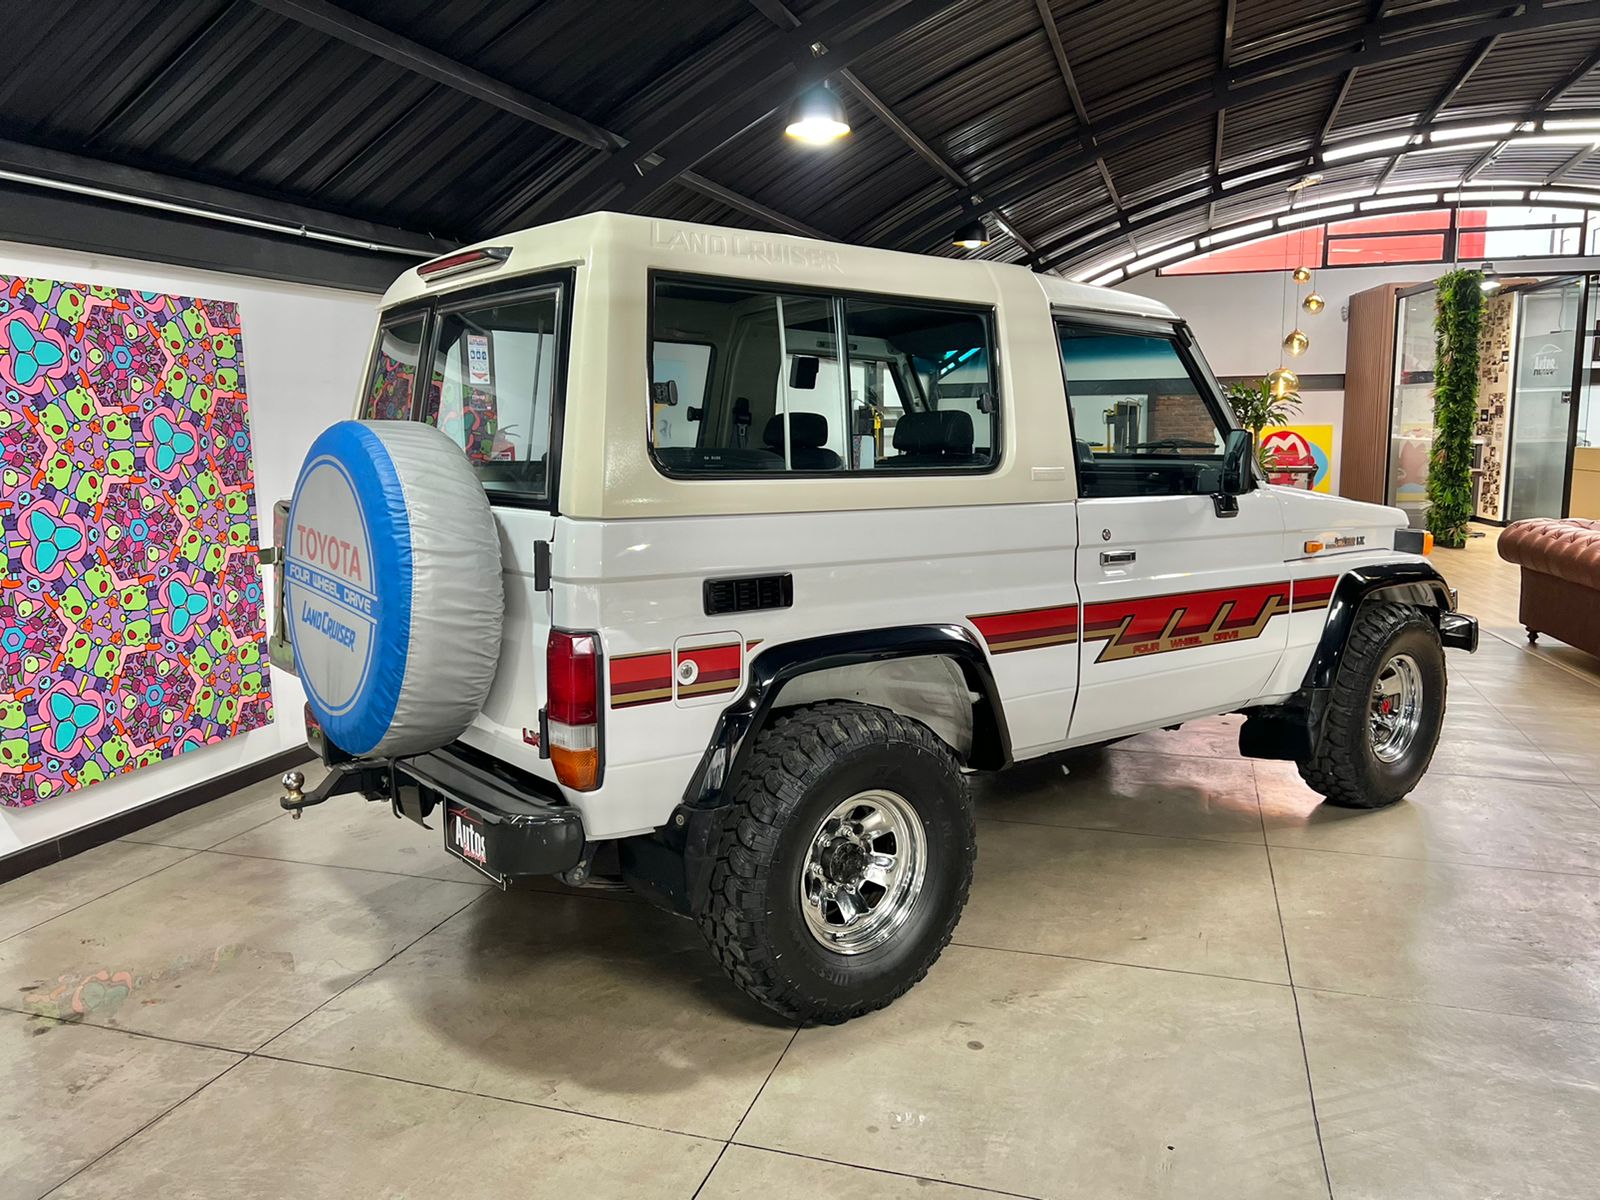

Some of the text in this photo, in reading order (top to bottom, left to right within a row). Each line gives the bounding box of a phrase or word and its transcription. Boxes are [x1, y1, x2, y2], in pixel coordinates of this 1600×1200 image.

[651, 220, 846, 274] LAND CRUISER
[297, 524, 362, 582] TOYOTA
[289, 563, 372, 614] FOUR WHEEL DRIVE
[1132, 630, 1239, 655] FOUR WHEEL DRIVE
[455, 815, 487, 859] Autos
